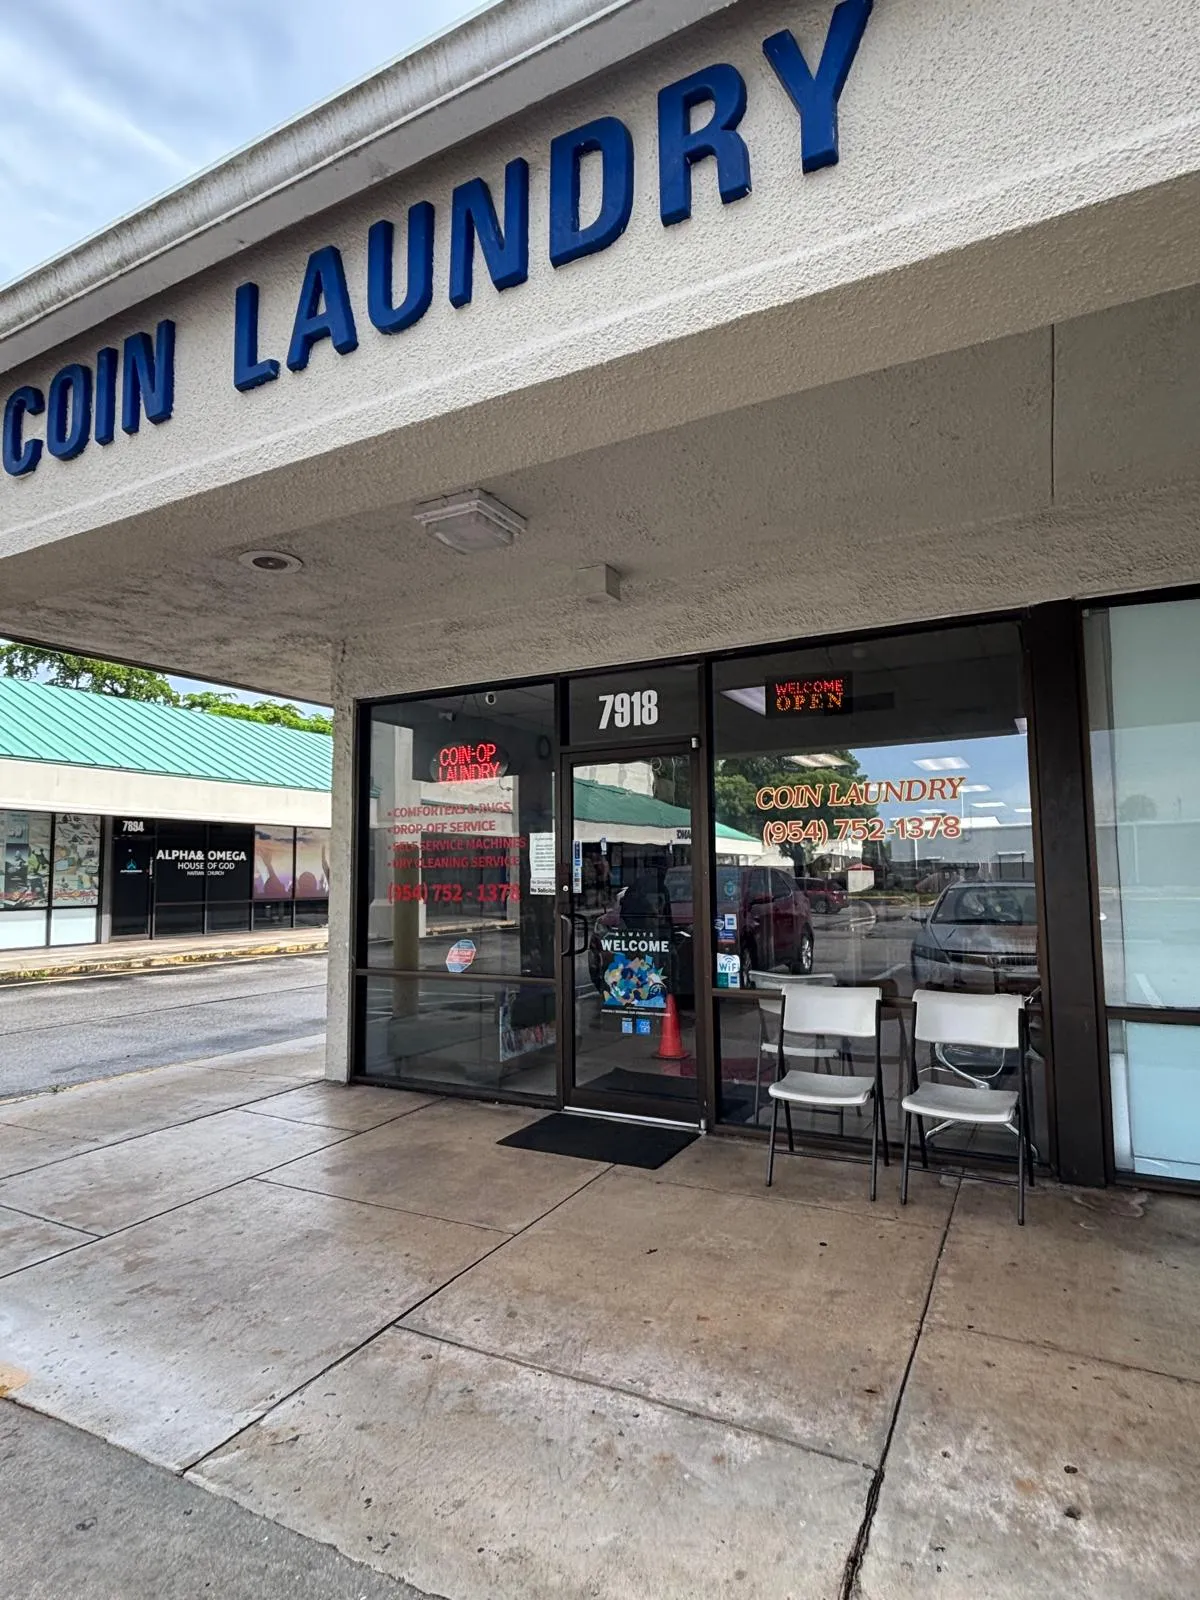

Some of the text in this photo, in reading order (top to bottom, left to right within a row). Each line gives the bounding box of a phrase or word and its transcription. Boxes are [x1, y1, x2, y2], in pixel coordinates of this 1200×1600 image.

[3, 0, 875, 477] COIN LAUNDRY
[775, 679, 844, 695] WELCOME
[598, 689, 658, 730] 7918
[776, 693, 843, 711] OPEN
[439, 744, 497, 767] COIN-OP
[438, 761, 500, 783] LAUNDRY
[756, 776, 966, 811] COIN LAUNDRY
[393, 805, 465, 819] COMFORTERS
[479, 802, 512, 814] RUGS
[394, 820, 496, 834] DROP-OFF SERVICE
[763, 815, 961, 847] (954) 752-1378
[466, 836, 528, 849] MACHINES
[207, 850, 247, 861] OMEGA
[415, 856, 469, 869] CLEANING
[471, 854, 520, 868] SERVICE
[177, 862, 235, 870] HOUSE OF GOD
[387, 882, 428, 904] (954)
[431, 884, 462, 901] 752
[476, 882, 520, 902] 1378
[601, 940, 669, 952] WELCOME
